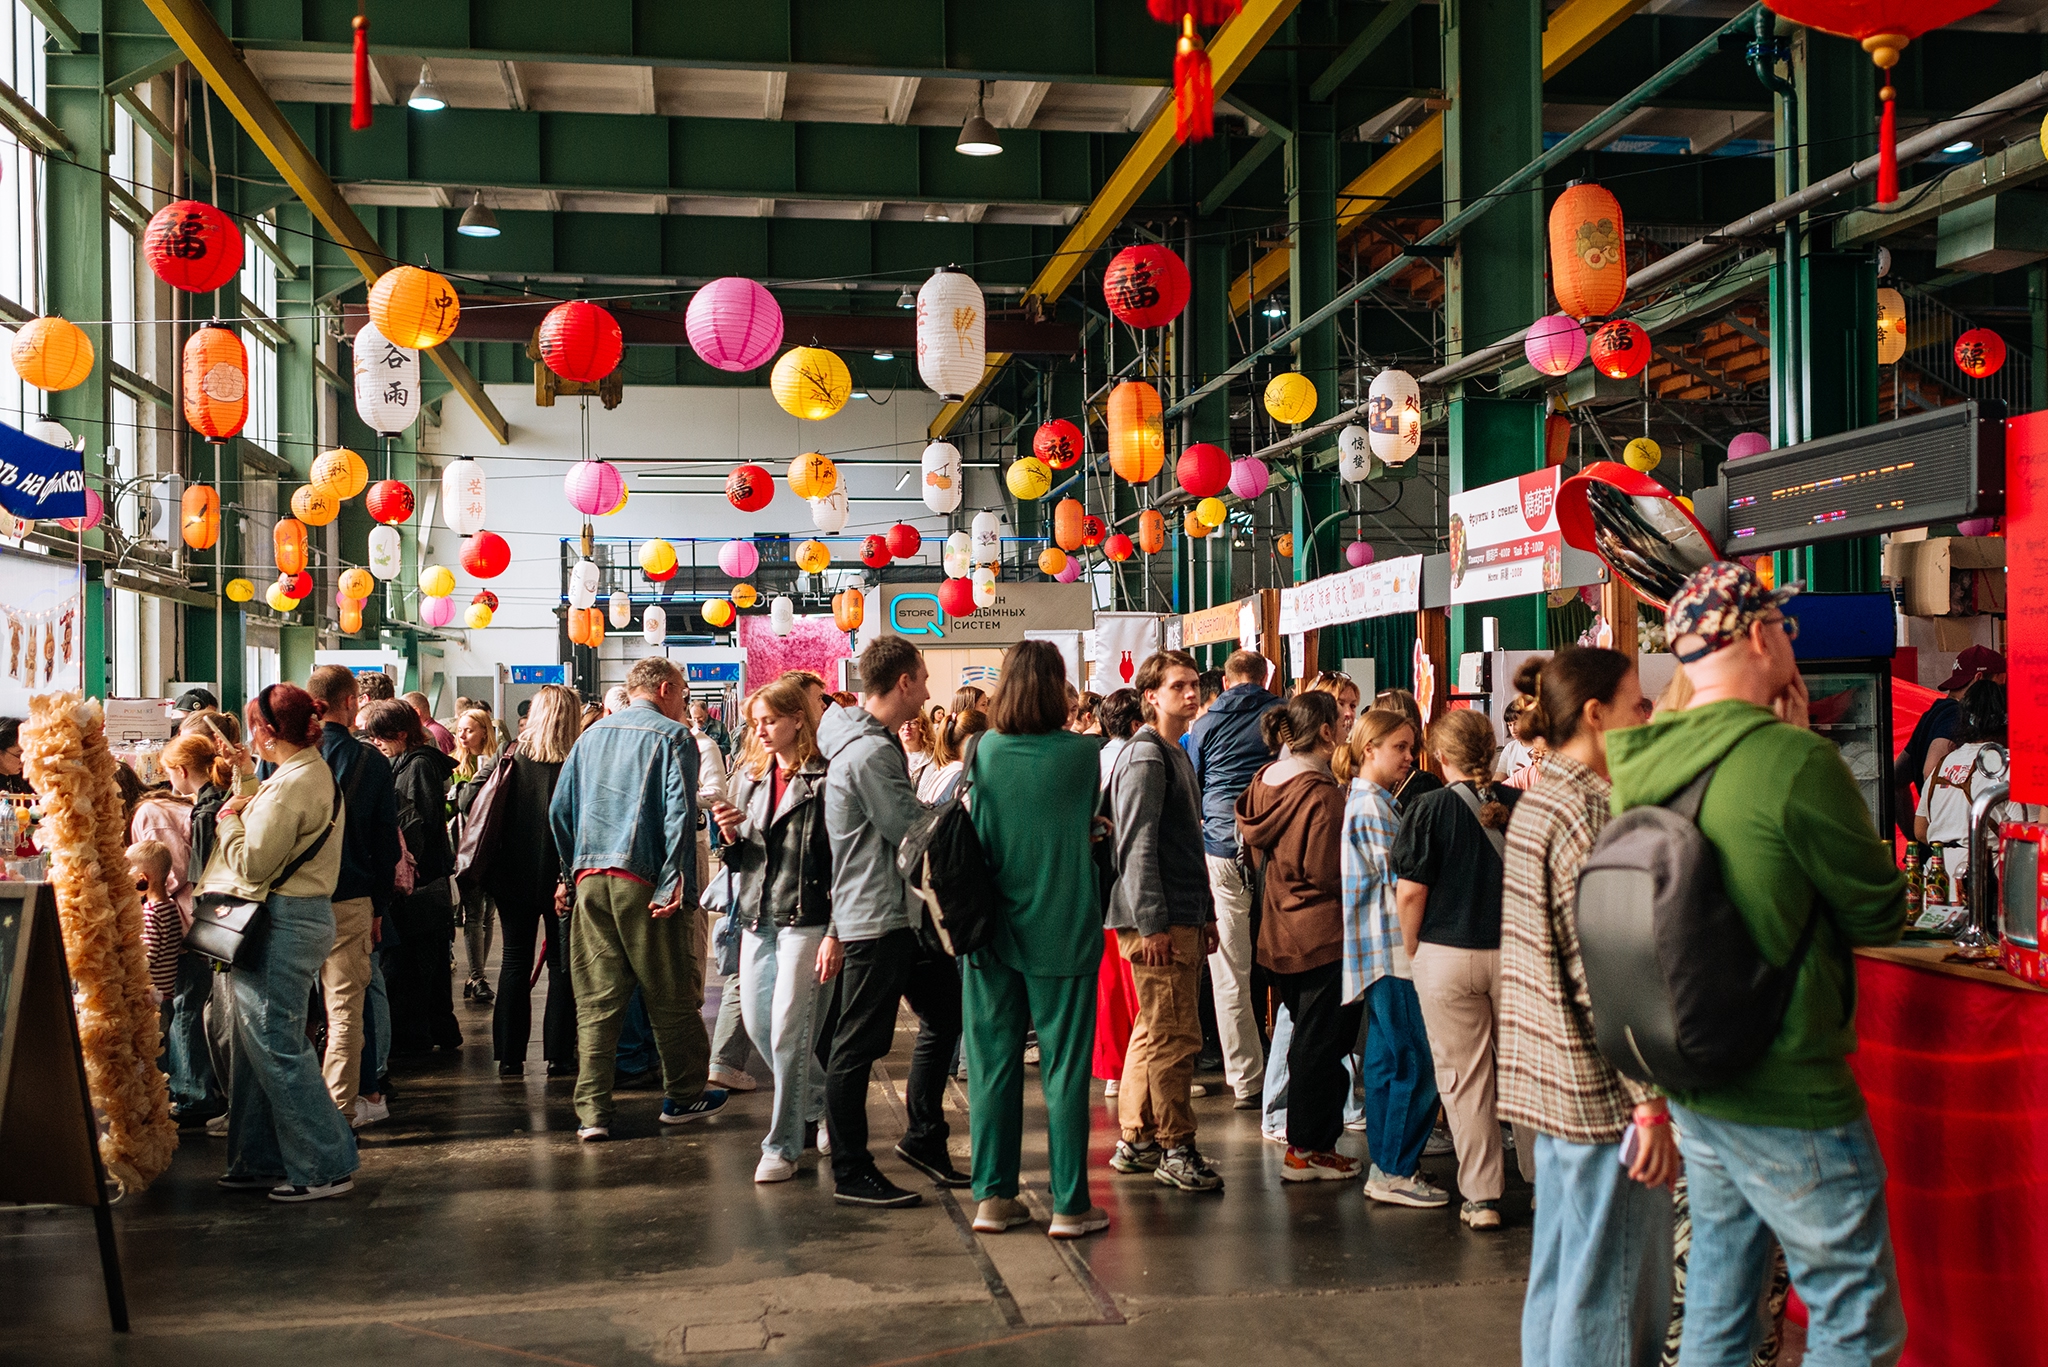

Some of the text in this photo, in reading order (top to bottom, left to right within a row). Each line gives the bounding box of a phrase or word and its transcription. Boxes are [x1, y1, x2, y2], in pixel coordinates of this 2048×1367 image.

[162, 213, 207, 260] 福
[1114, 262, 1160, 310] 福
[1602, 324, 1633, 351] 福
[1959, 341, 1986, 370] 福
[379, 342, 411, 407] 谷雨
[1403, 393, 1420, 445] 处暑
[1047, 436, 1074, 463] 福
[1351, 437, 1366, 469] 惊蛰
[810, 457, 835, 482] 中秋
[16, 472, 46, 496] на
[899, 609, 934, 617] STORE
[954, 621, 1000, 630] СИСТЕМ
[967, 608, 1026, 618] ДЫМНЫХ
